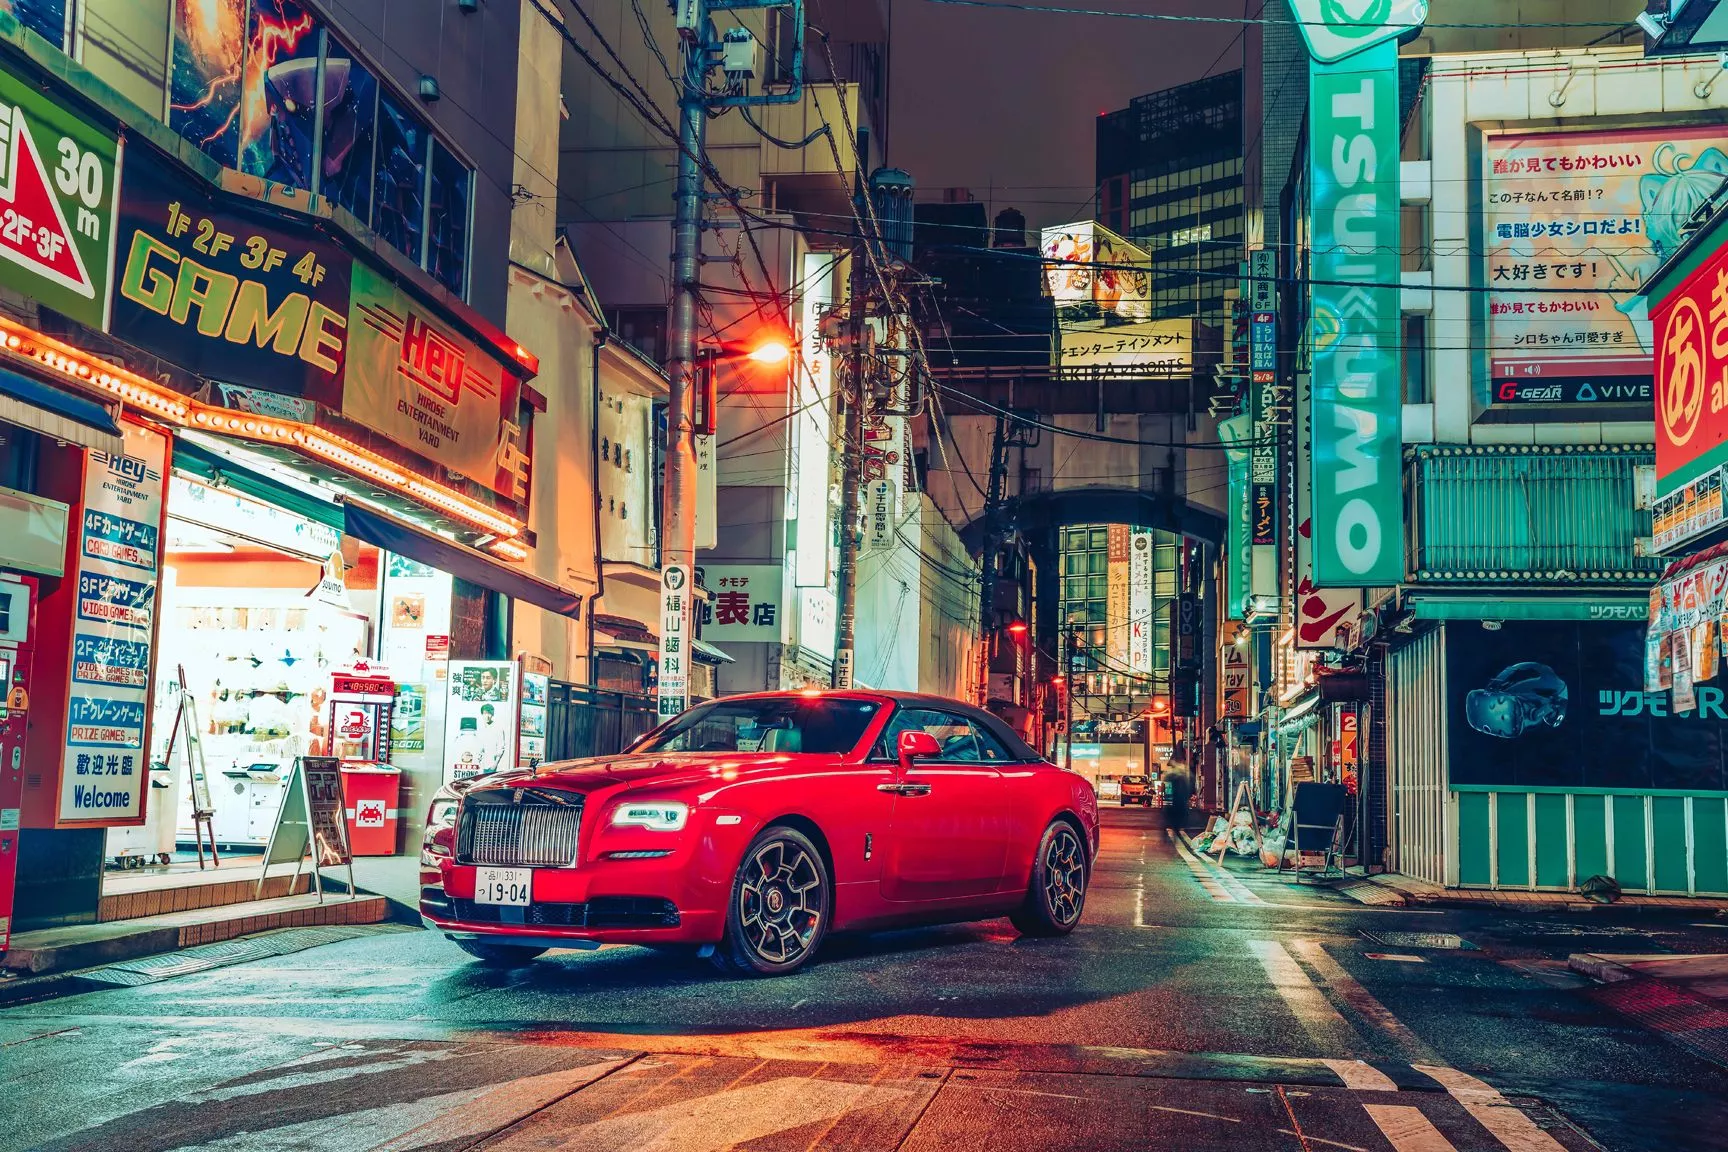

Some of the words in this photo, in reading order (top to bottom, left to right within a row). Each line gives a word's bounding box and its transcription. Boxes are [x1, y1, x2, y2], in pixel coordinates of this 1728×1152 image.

[55, 137, 103, 208] 30
[1493, 154, 1641, 174] 誰が見てもかわいい
[1489, 189, 1603, 203] この子なんて名前！？
[77, 206, 99, 240] m
[1497, 218, 1640, 239] 電脳少女シロだよ！
[166, 201, 191, 238] 1F
[192, 219, 235, 257] 2F
[240, 236, 287, 272] 3F
[292, 251, 326, 287] 4F
[1493, 262, 1598, 281] 大好きです！
[121, 229, 347, 375] GAME
[1255, 301, 1271, 309] 6F
[1257, 314, 1270, 322] 4F
[1332, 79, 1381, 574] TSUKUMO
[1264, 325, 1273, 367] らしんばん
[1514, 331, 1624, 345] シロちゃん可愛すぎ
[400, 311, 466, 406] Hey
[1668, 314, 1701, 428] あ
[1498, 382, 1563, 399] G-GEAR
[1601, 385, 1650, 397] VIVE
[417, 393, 446, 419] HIROSE
[397, 399, 460, 443] ENTERTAINMENT
[419, 427, 440, 449] YARD
[103, 482, 149, 501] ENTERTAINMENT
[116, 478, 137, 489] HIROSE
[1257, 497, 1270, 536] ラーメン
[111, 545, 138, 563] GAMES
[719, 577, 749, 587] オモテ
[82, 601, 107, 617] VIDEO
[1182, 600, 1193, 634] DVD
[664, 595, 681, 674] 福山歯科
[77, 640, 93, 656] 2F
[72, 727, 99, 740] PRIZE
[101, 729, 125, 741] GAMES
[76, 754, 133, 775] 歡迎光臨
[74, 784, 130, 809] Welcome
[489, 871, 503, 880] 品川
[505, 871, 517, 880] 331
[489, 883, 527, 902] 19-04
